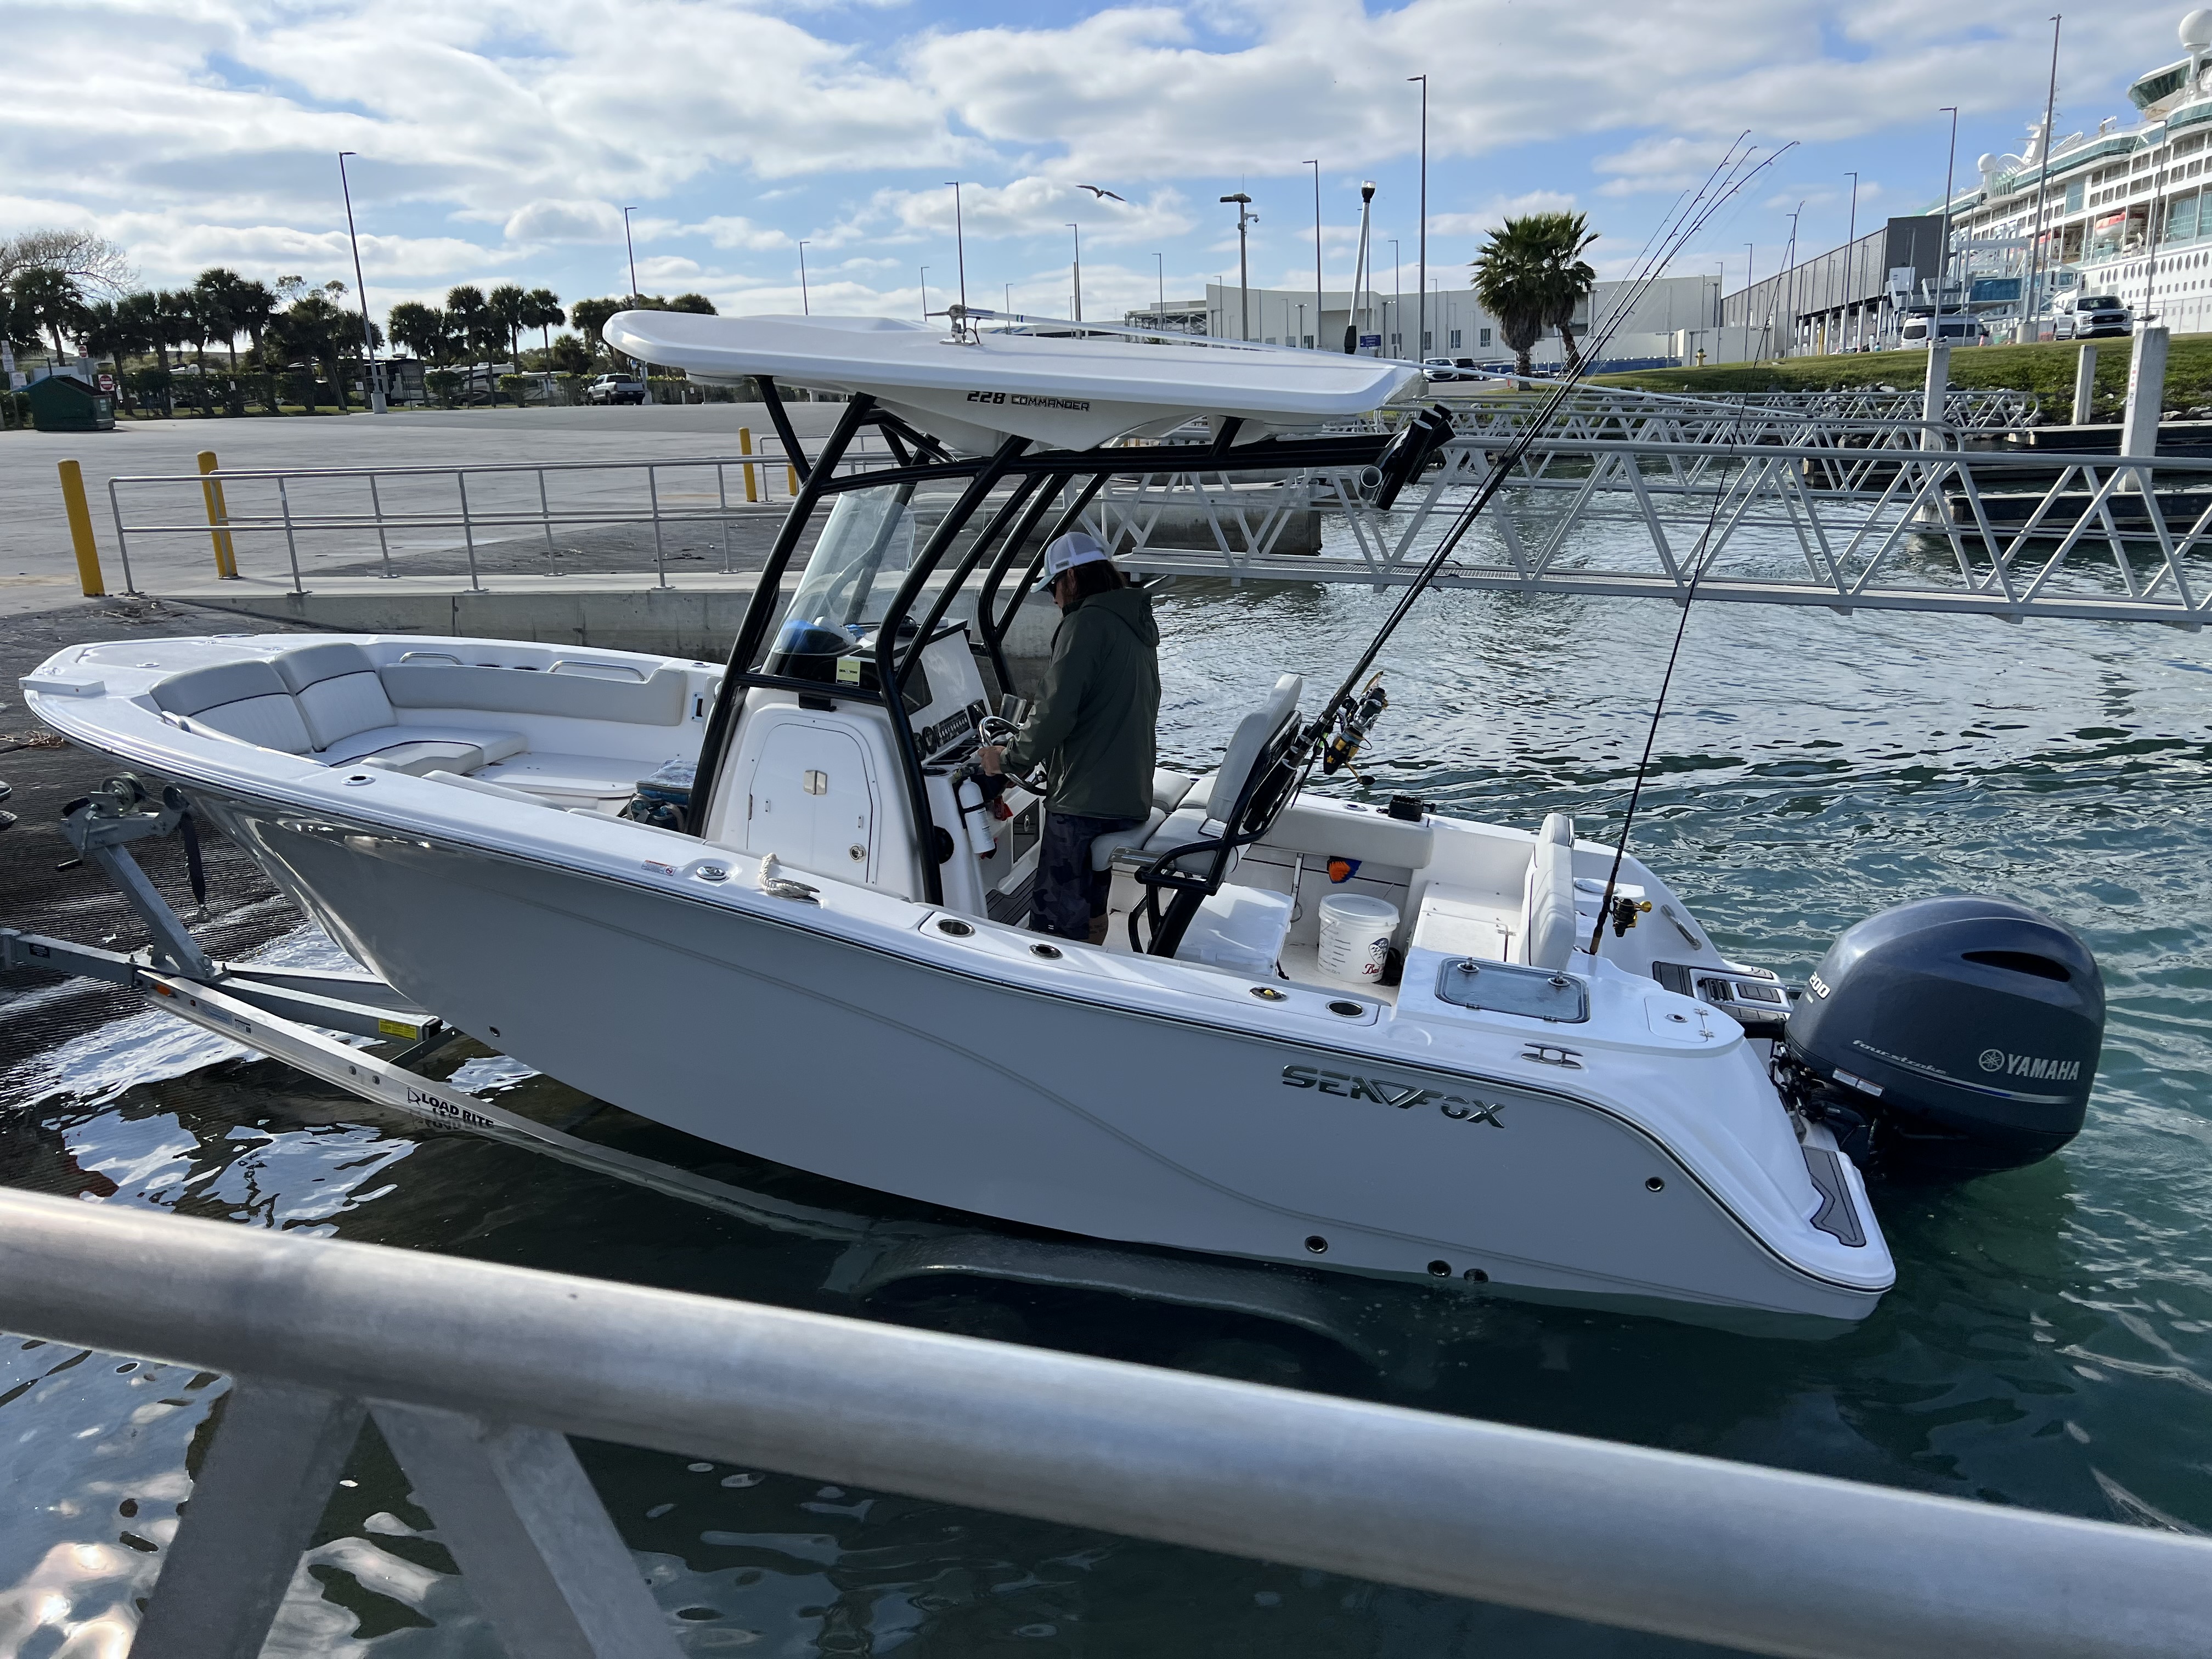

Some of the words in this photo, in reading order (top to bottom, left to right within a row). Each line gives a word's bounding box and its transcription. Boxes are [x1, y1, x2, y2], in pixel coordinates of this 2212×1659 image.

[967, 390, 1006, 405] 228
[1011, 394, 1090, 411] COMMANDER
[1809, 971, 1831, 999] 200
[2006, 1053, 2081, 1081] YAMAHA
[422, 1093, 459, 1115] LOAD
[462, 1110, 494, 1128] RITE
